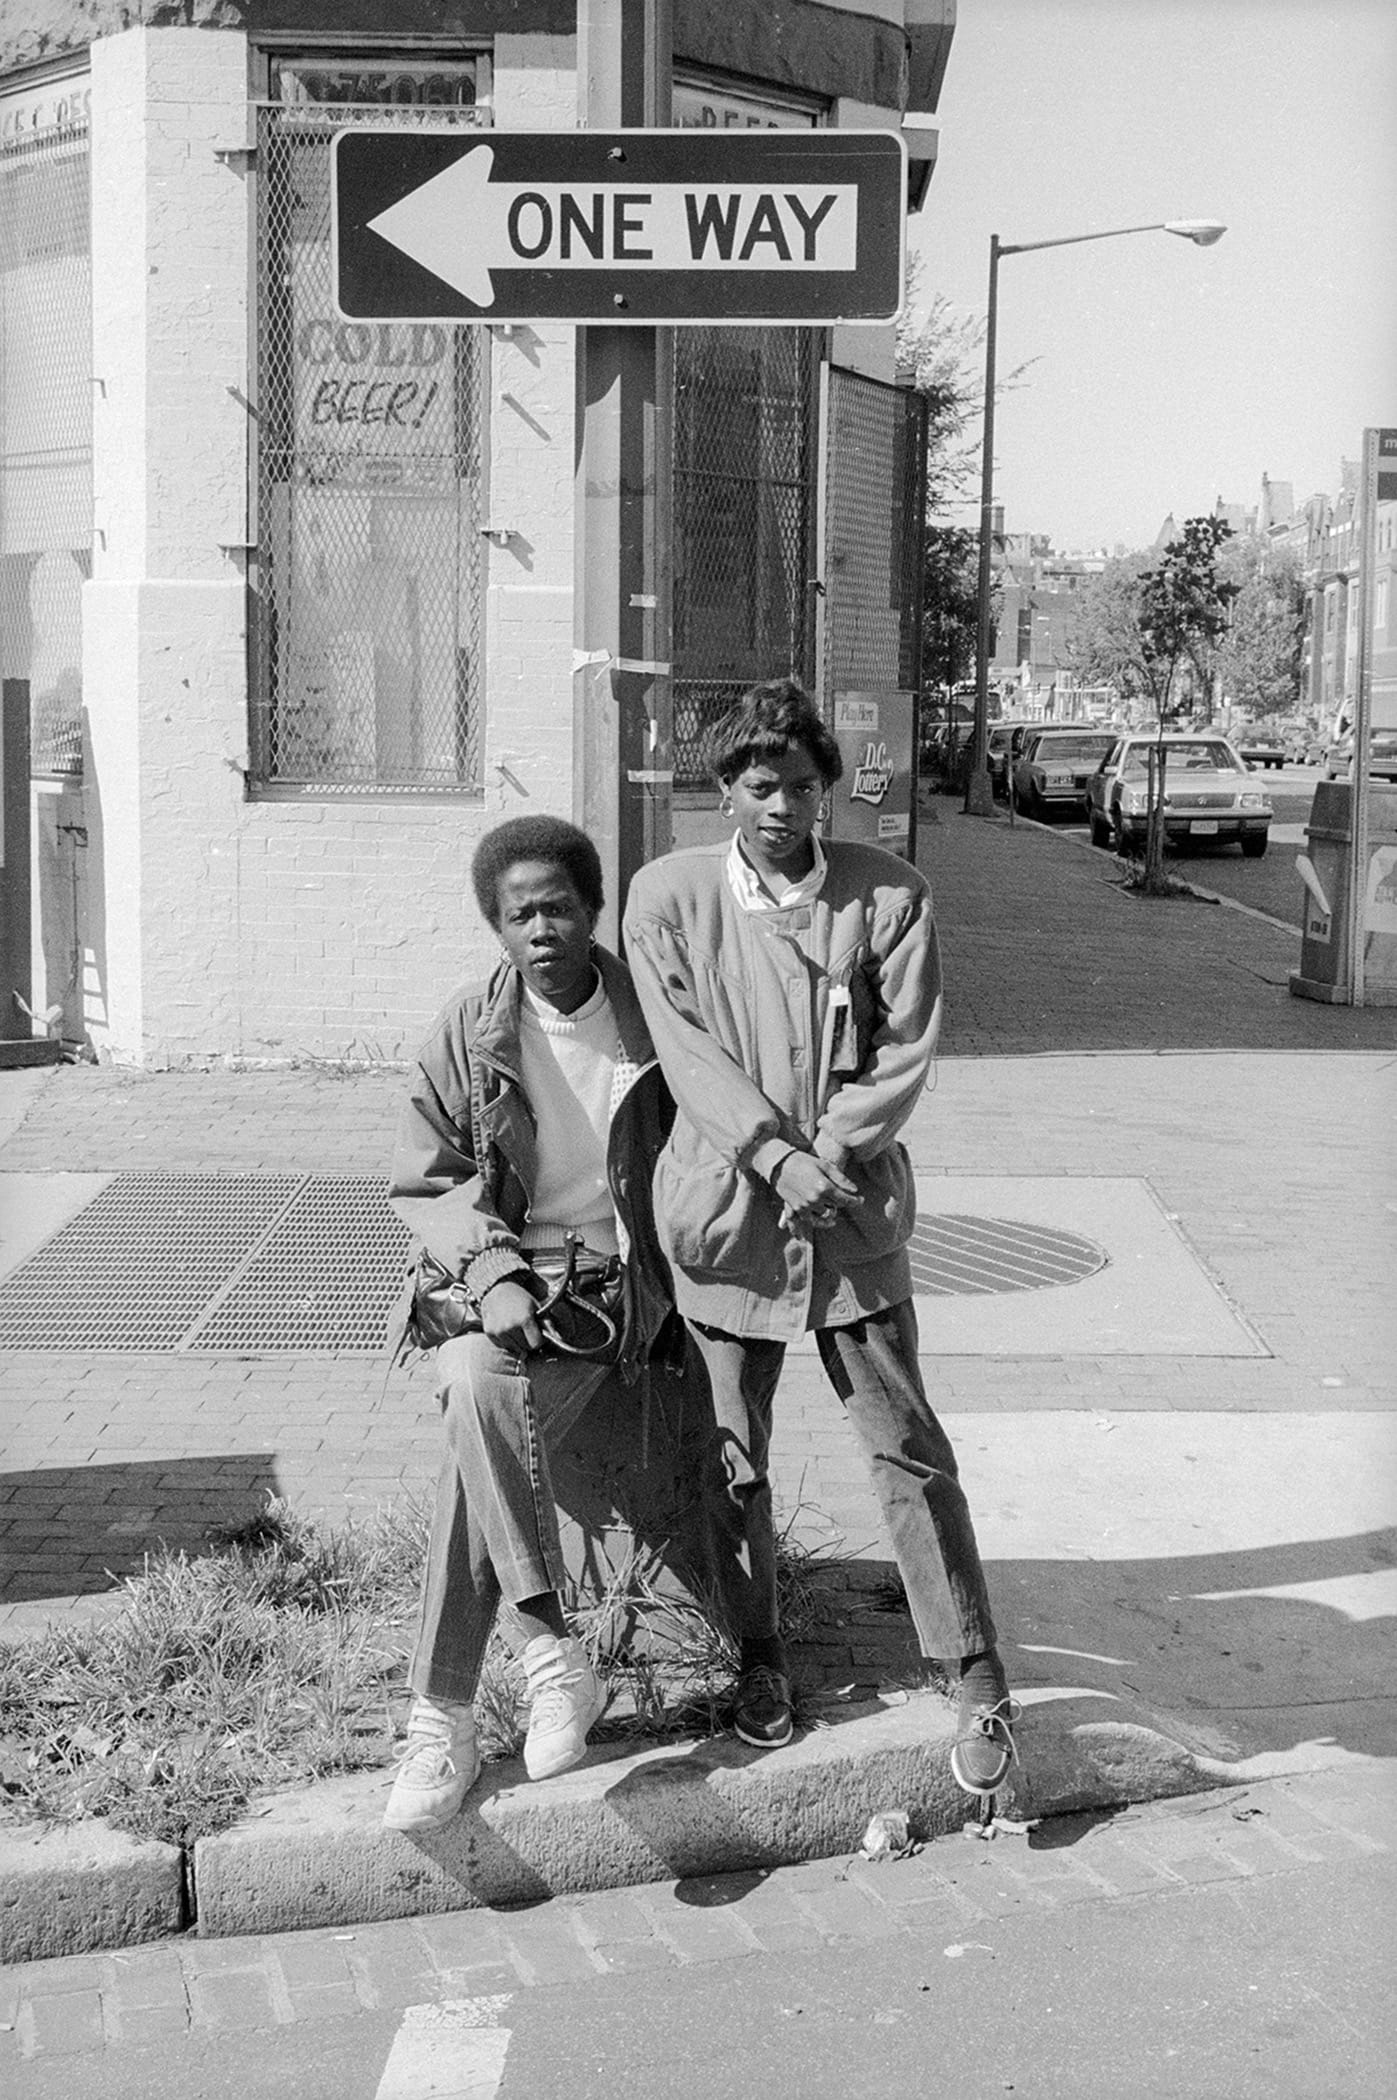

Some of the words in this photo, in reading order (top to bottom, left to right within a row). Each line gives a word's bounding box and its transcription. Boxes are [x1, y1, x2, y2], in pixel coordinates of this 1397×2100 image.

[507, 191, 653, 260] ONE
[684, 193, 838, 261] WAY
[300, 319, 446, 368] COLD
[312, 380, 438, 429] BEER!
[851, 760, 894, 803] Lottery
